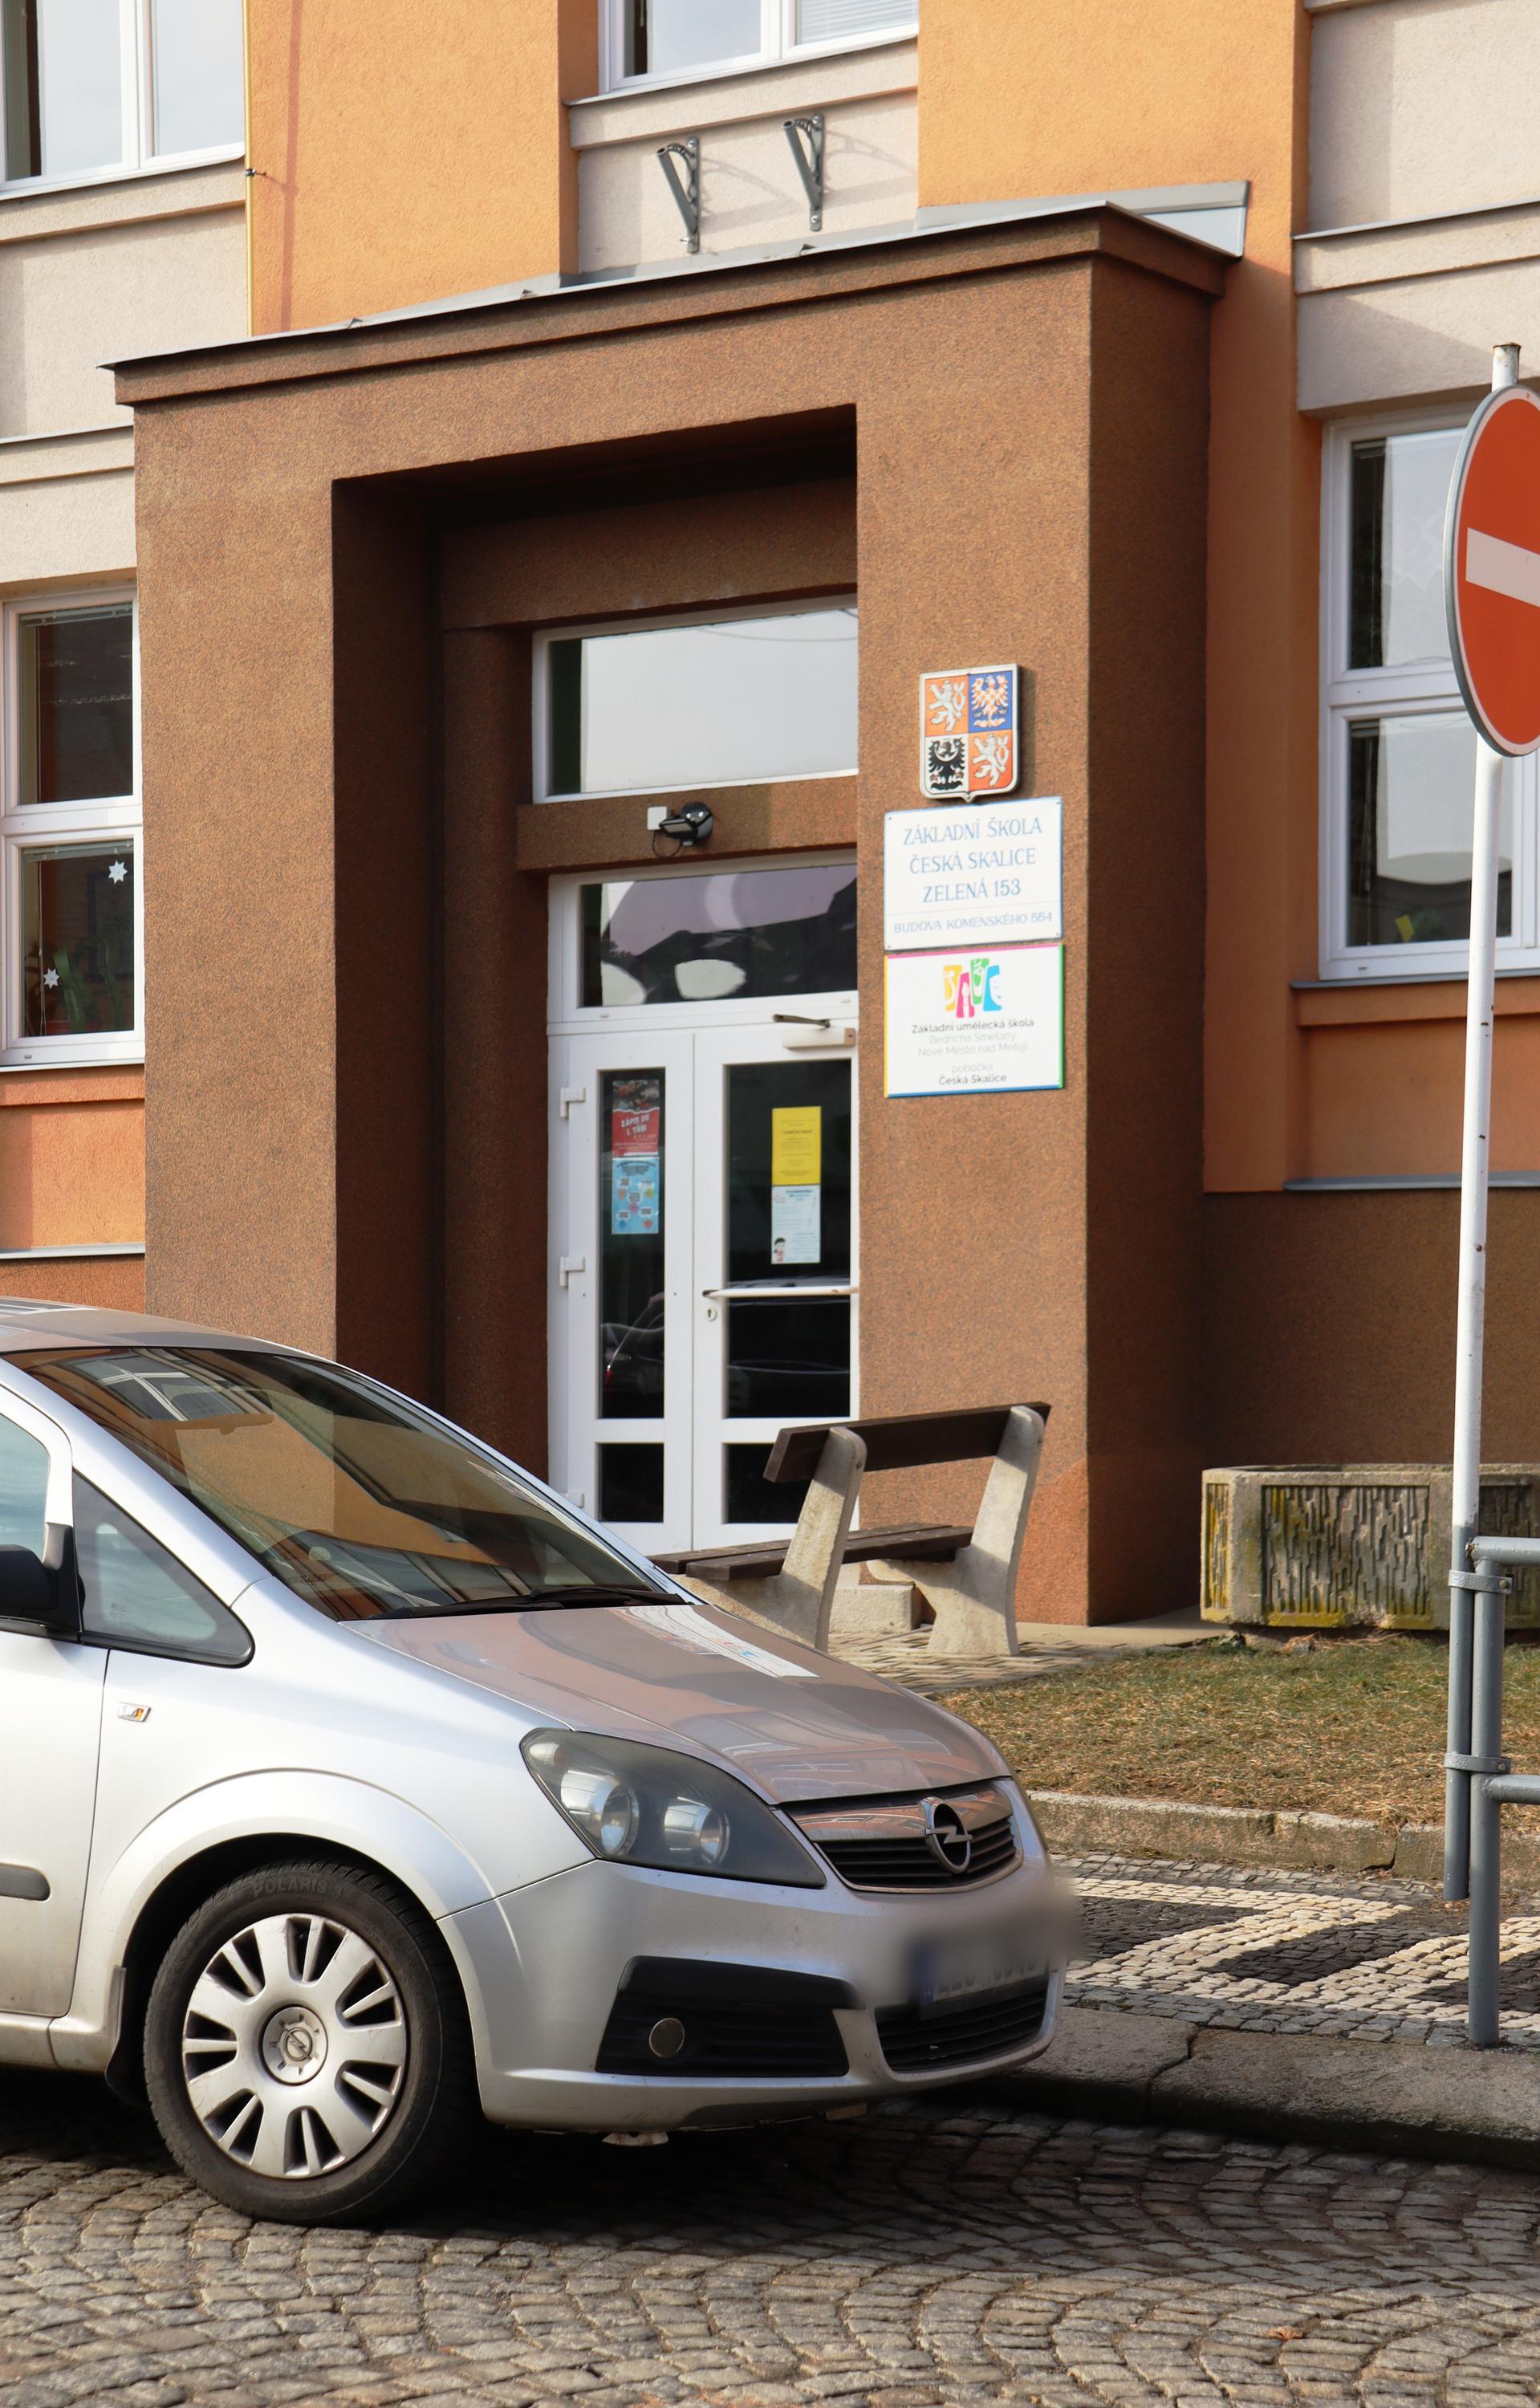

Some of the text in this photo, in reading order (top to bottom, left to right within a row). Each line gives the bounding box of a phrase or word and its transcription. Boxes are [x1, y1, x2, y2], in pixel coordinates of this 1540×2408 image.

[904, 817, 1042, 845] ZÁKLADNÍ ŠKOLA
[909, 848, 1036, 874] ČESKÁ SKALICE
[923, 878, 1021, 903] ZELENÁ 153
[893, 920, 942, 934] BUDOVA
[946, 913, 1027, 929] KOMENSKÉHO
[912, 1019, 1034, 1034] Základní umělecká škola
[939, 1073, 1006, 1085] Česká Skalice
